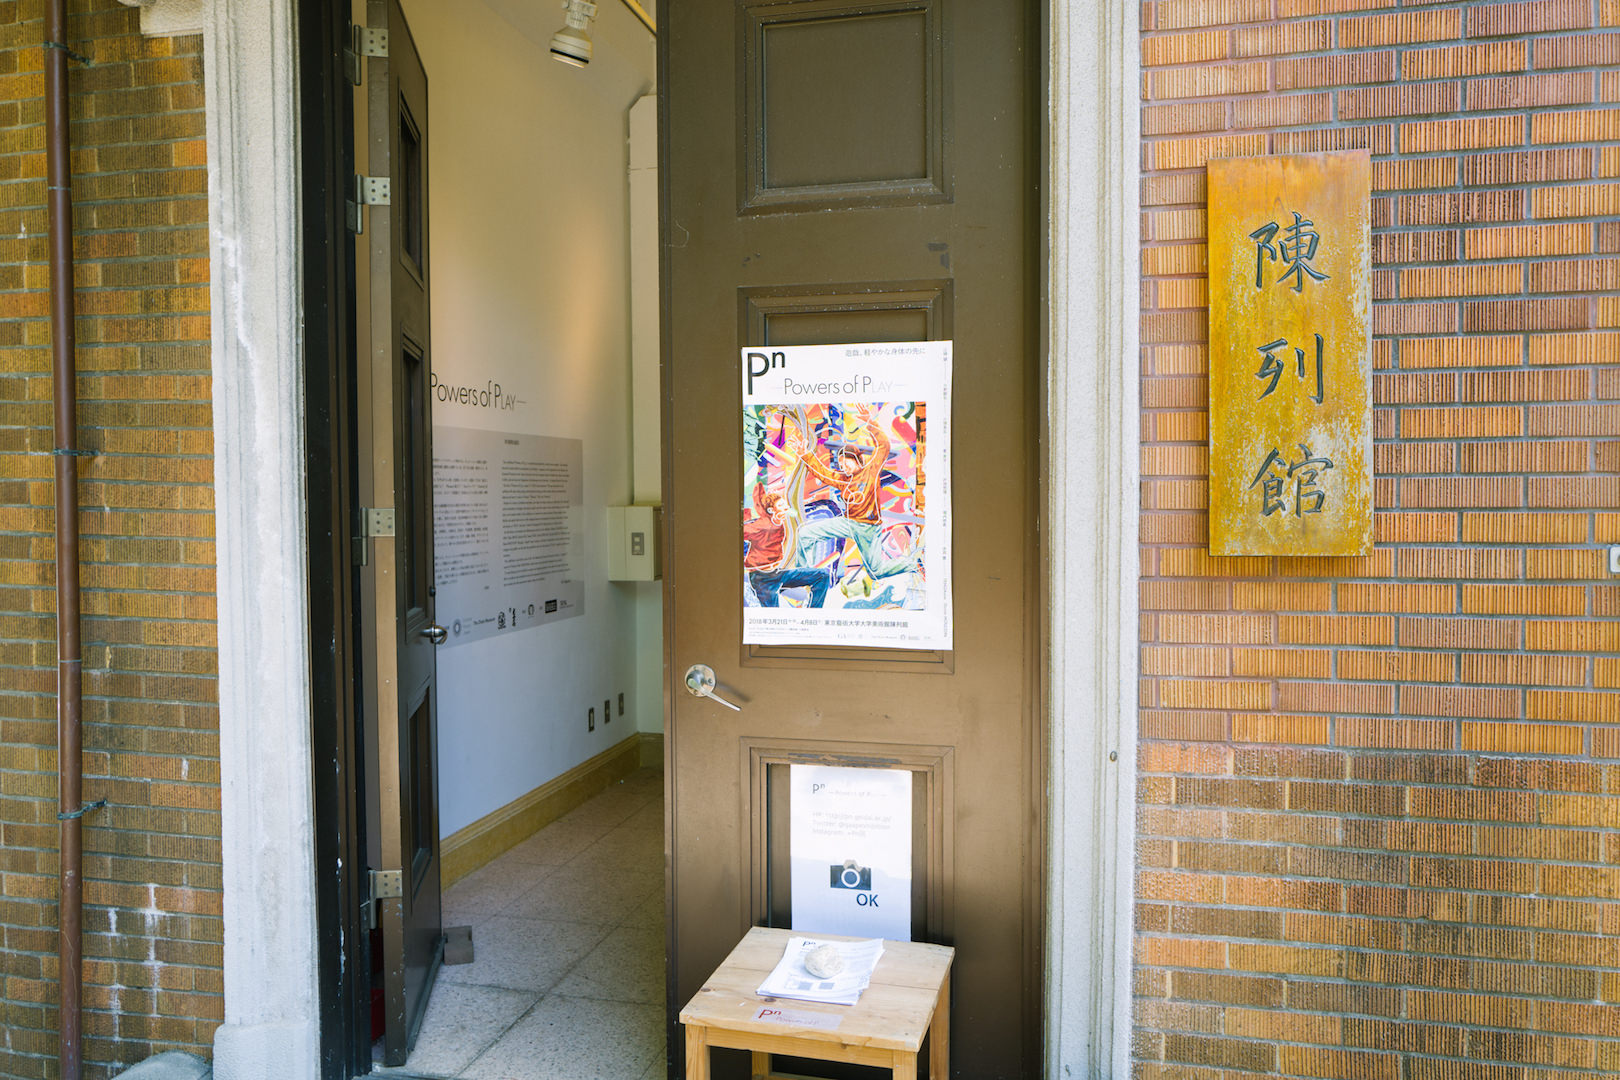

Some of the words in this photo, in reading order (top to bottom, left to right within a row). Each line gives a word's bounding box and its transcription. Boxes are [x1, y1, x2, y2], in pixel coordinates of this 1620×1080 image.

[1248, 210, 1334, 519] 陳列館
[479, 380, 493, 408] of
[784, 377, 840, 396] Powers
[842, 374, 858, 394] of
[856, 893, 879, 907] OK
